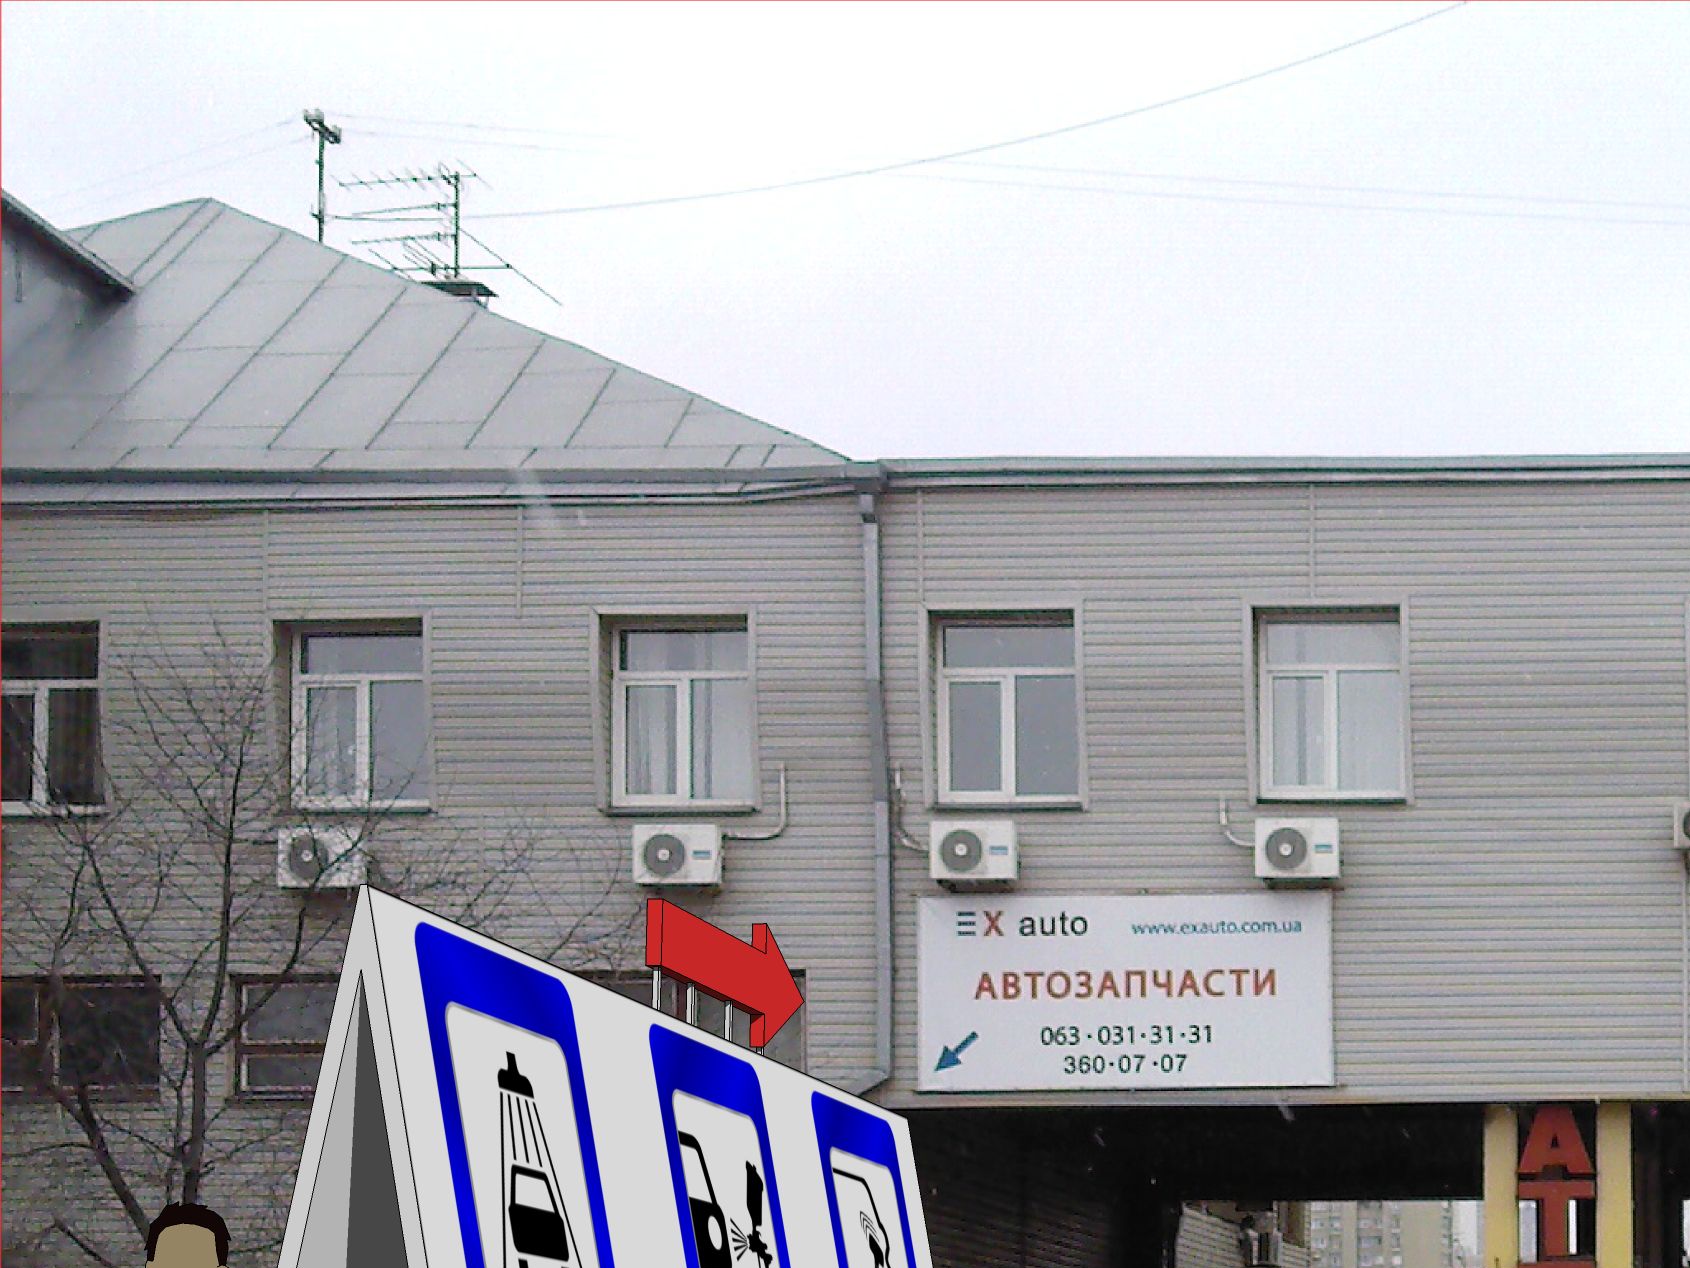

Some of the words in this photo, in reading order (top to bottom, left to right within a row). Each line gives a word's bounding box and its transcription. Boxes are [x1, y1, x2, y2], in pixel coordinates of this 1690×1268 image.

[1019, 911, 1089, 937] auto
[1131, 918, 1303, 936] www.exauto.com.ua
[974, 968, 1278, 1000] АВТОЗАПЧАСТИ
